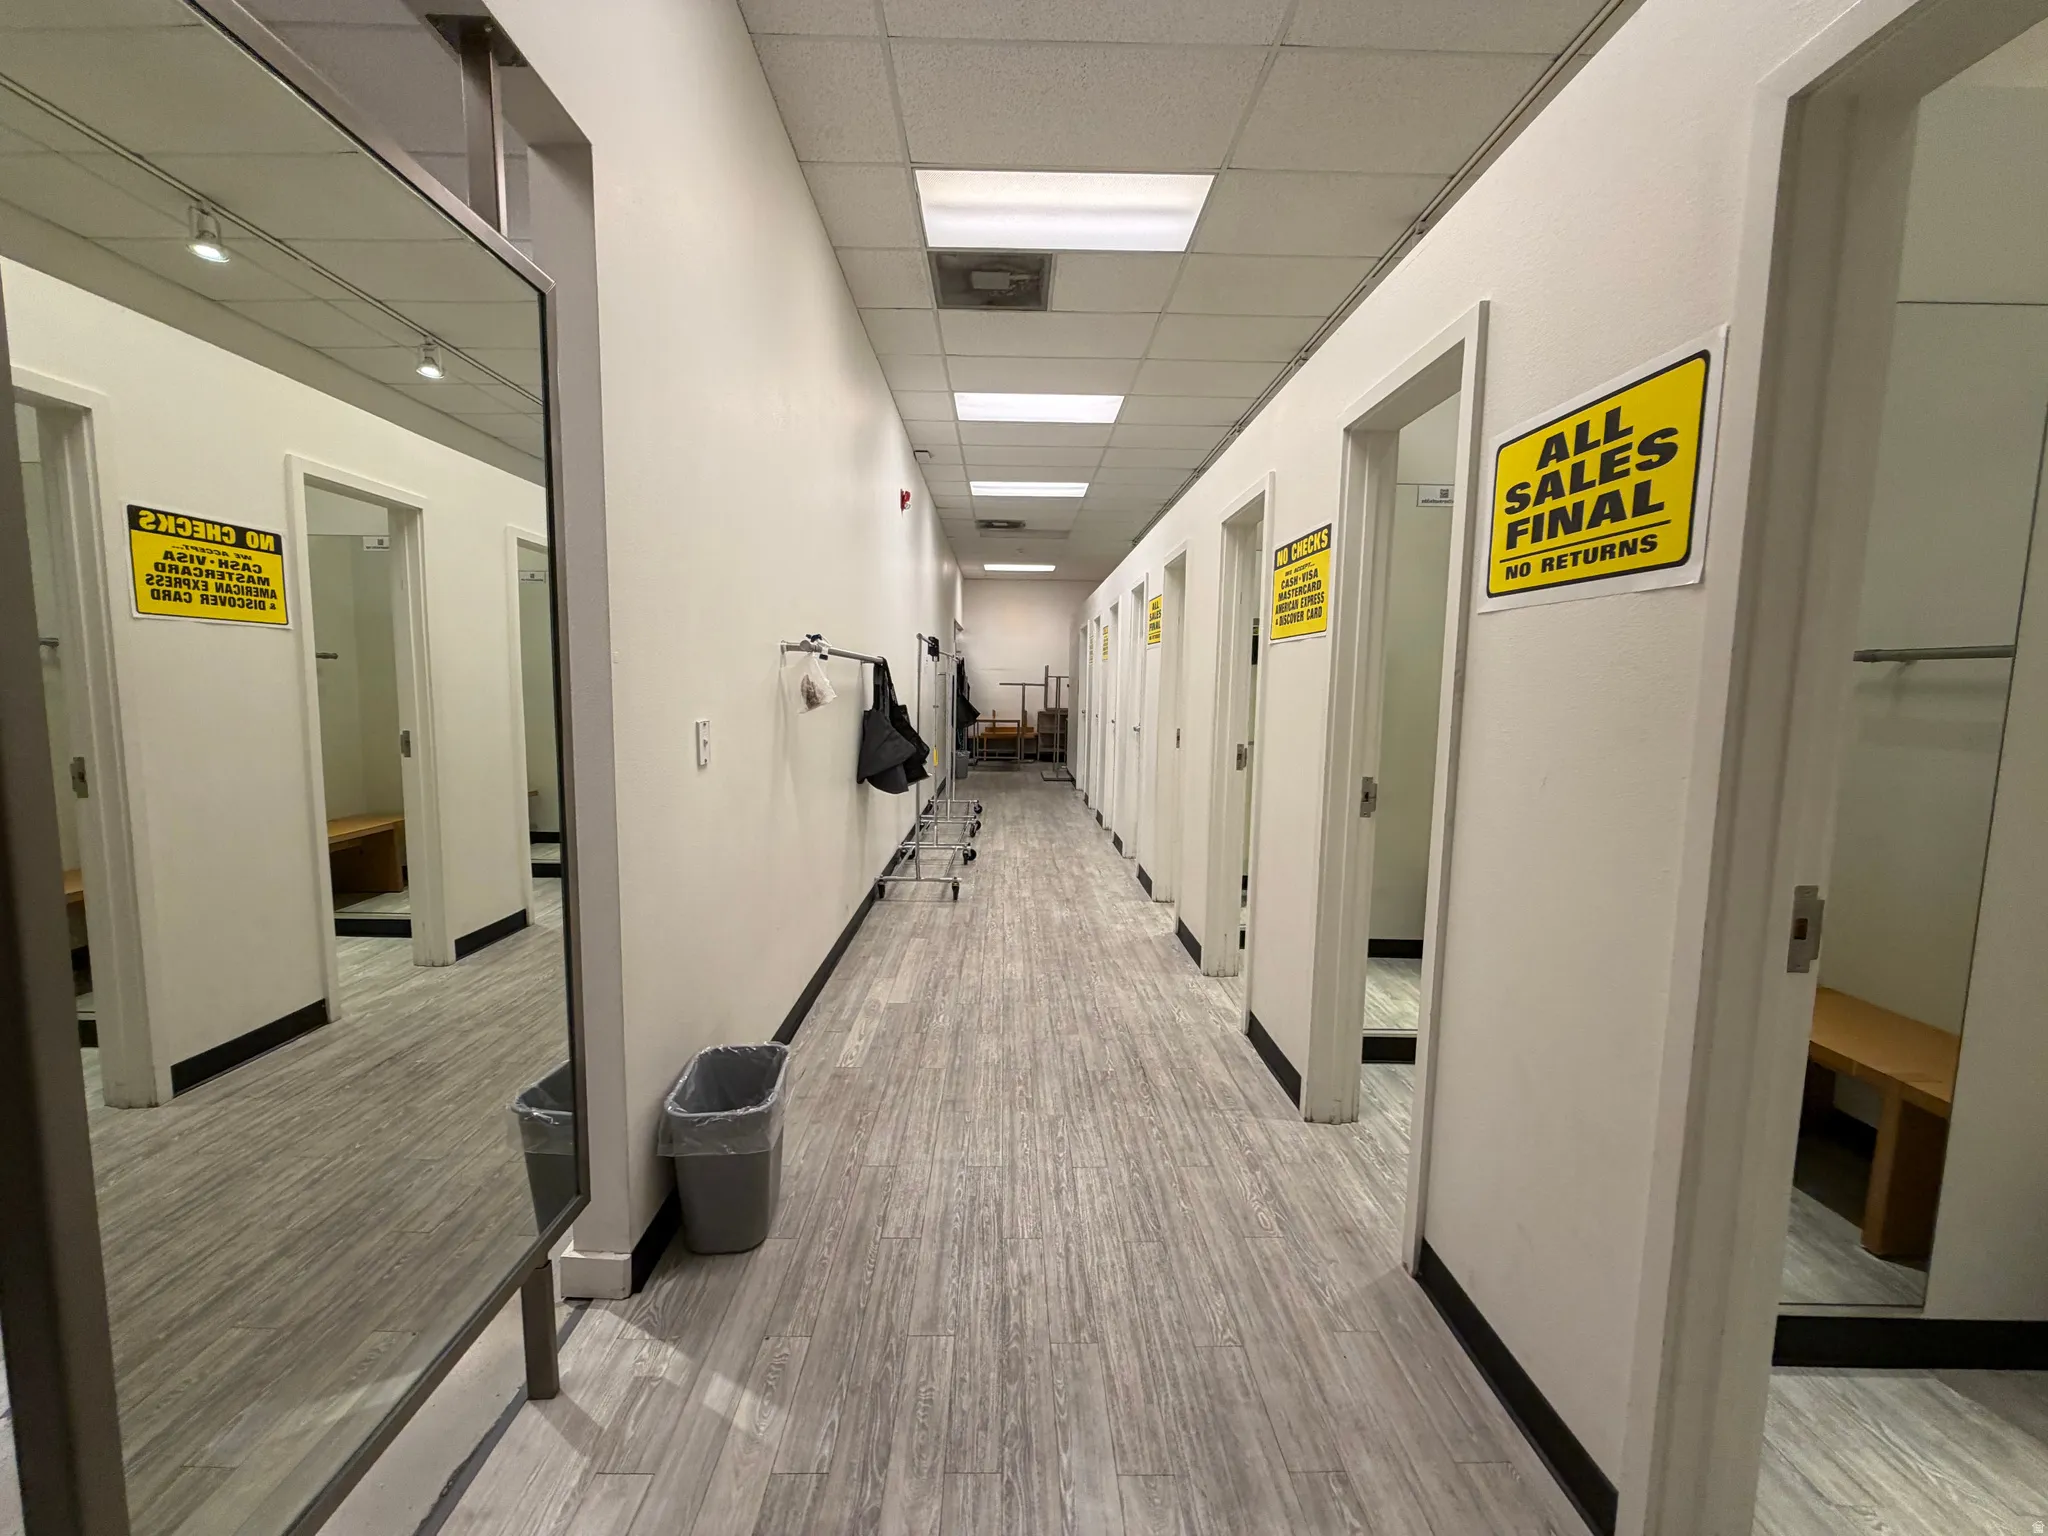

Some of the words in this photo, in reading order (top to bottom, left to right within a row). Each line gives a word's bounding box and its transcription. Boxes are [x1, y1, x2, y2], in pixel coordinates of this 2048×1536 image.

[1536, 406, 1634, 471] ALL
[1505, 427, 1679, 515] SALES
[1506, 479, 1665, 550] FINAL
[1277, 547, 1288, 567] NO
[1292, 528, 1328, 561] CHECKS
[1505, 561, 1531, 580] NO
[1541, 533, 1658, 573] RETURNS
[1275, 598, 1299, 615] AMERICAN
[1300, 591, 1325, 609] EXPRESS
[1278, 579, 1322, 602] MASTERCARD
[1279, 610, 1304, 627] DISCOVER
[1307, 606, 1322, 620] CARD
